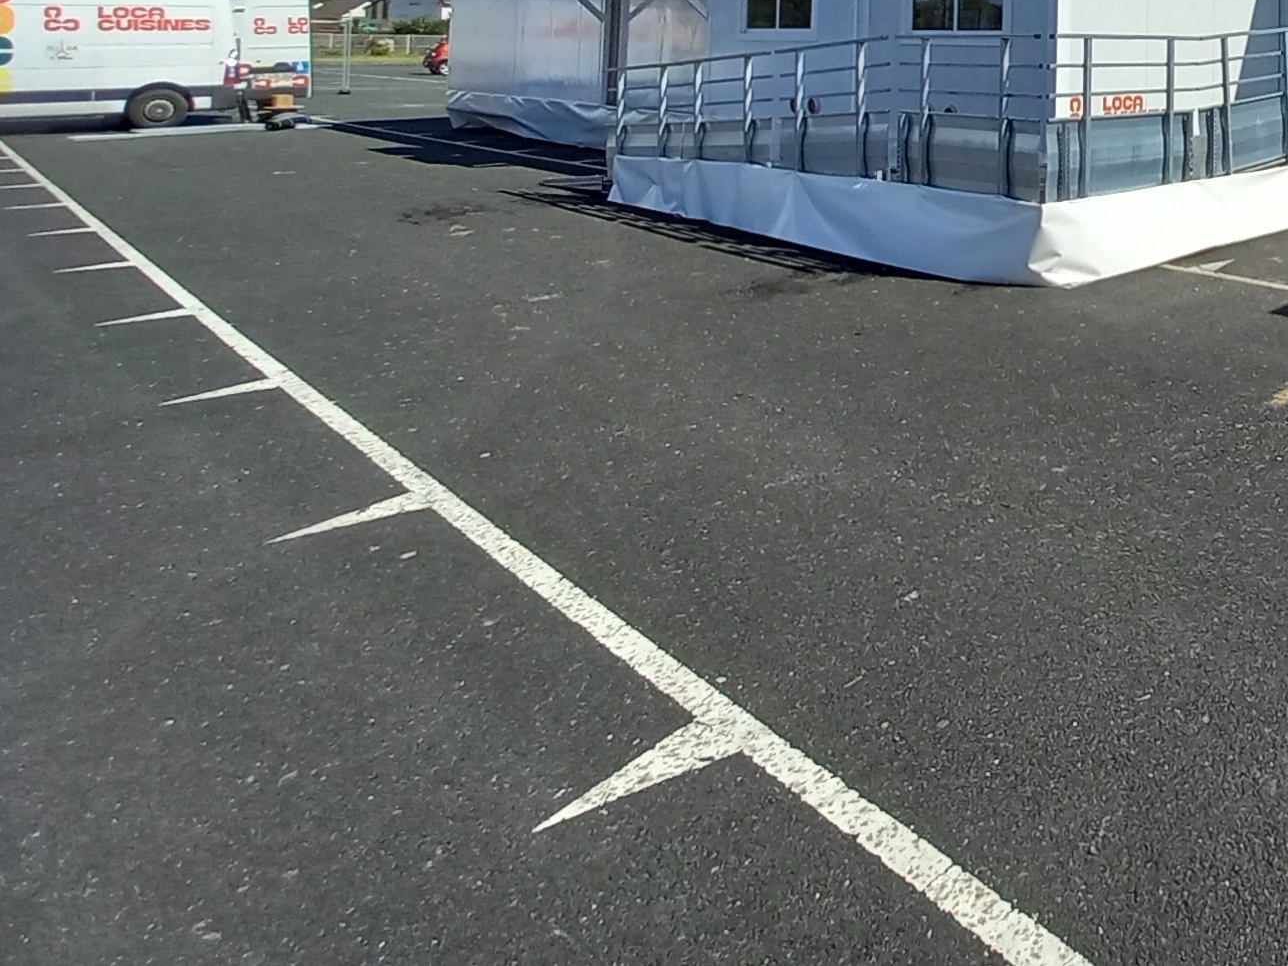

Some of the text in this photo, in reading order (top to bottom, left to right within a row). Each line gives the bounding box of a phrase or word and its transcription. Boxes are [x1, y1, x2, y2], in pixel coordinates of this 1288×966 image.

[97, 6, 166, 19] LOCA
[97, 19, 212, 31] CUISINES
[1102, 95, 1143, 111] LOCA
